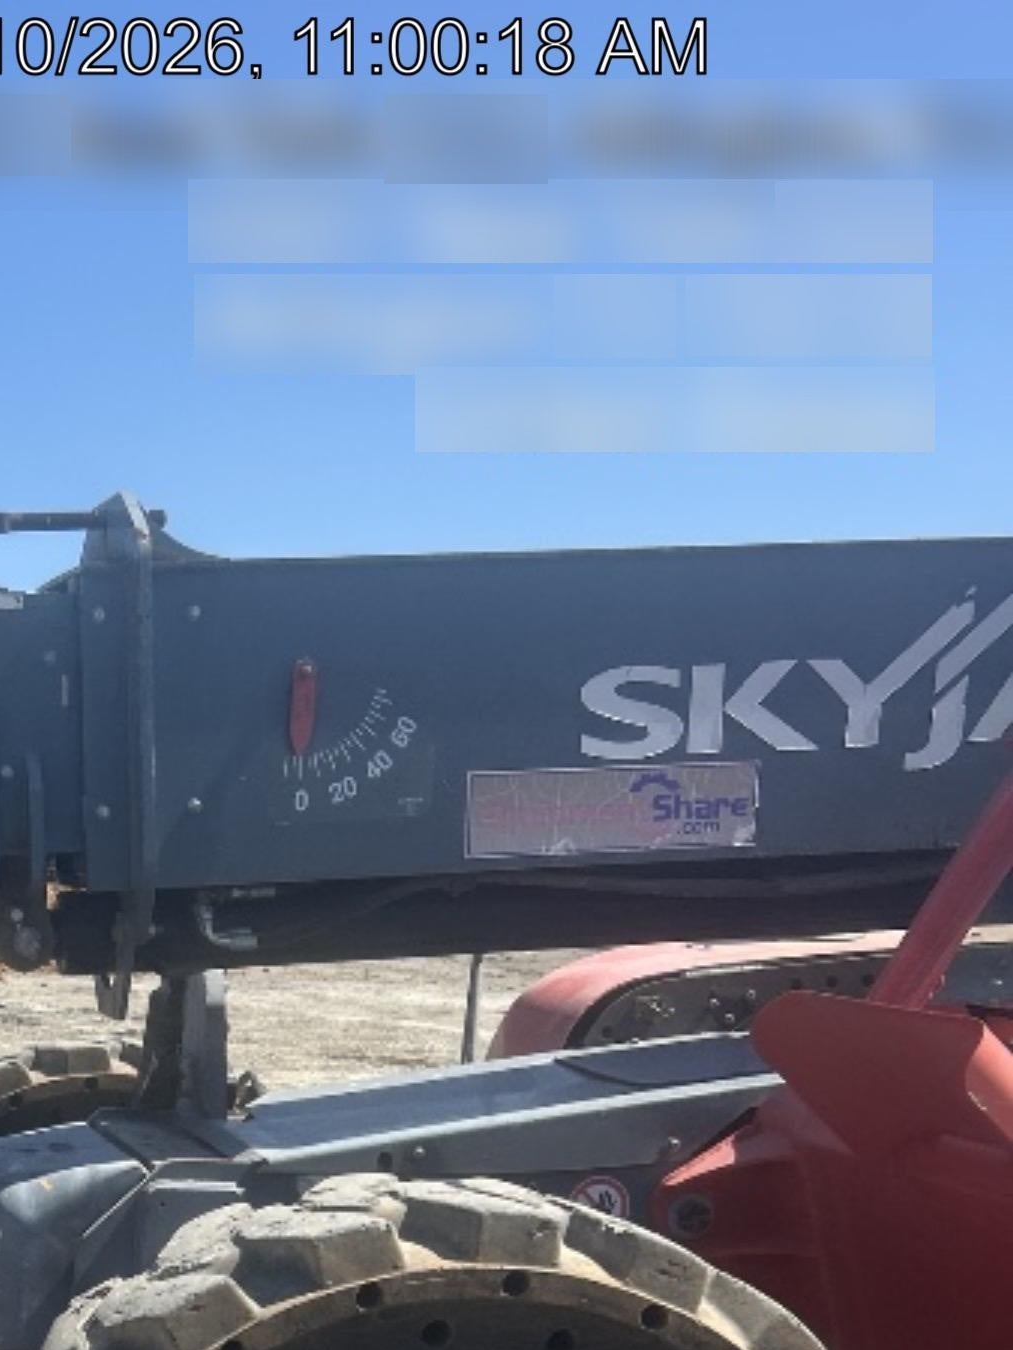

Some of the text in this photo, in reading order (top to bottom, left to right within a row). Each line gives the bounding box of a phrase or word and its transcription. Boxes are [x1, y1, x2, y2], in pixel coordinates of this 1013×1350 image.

[295, 716, 417, 811] 0 20 40 60
